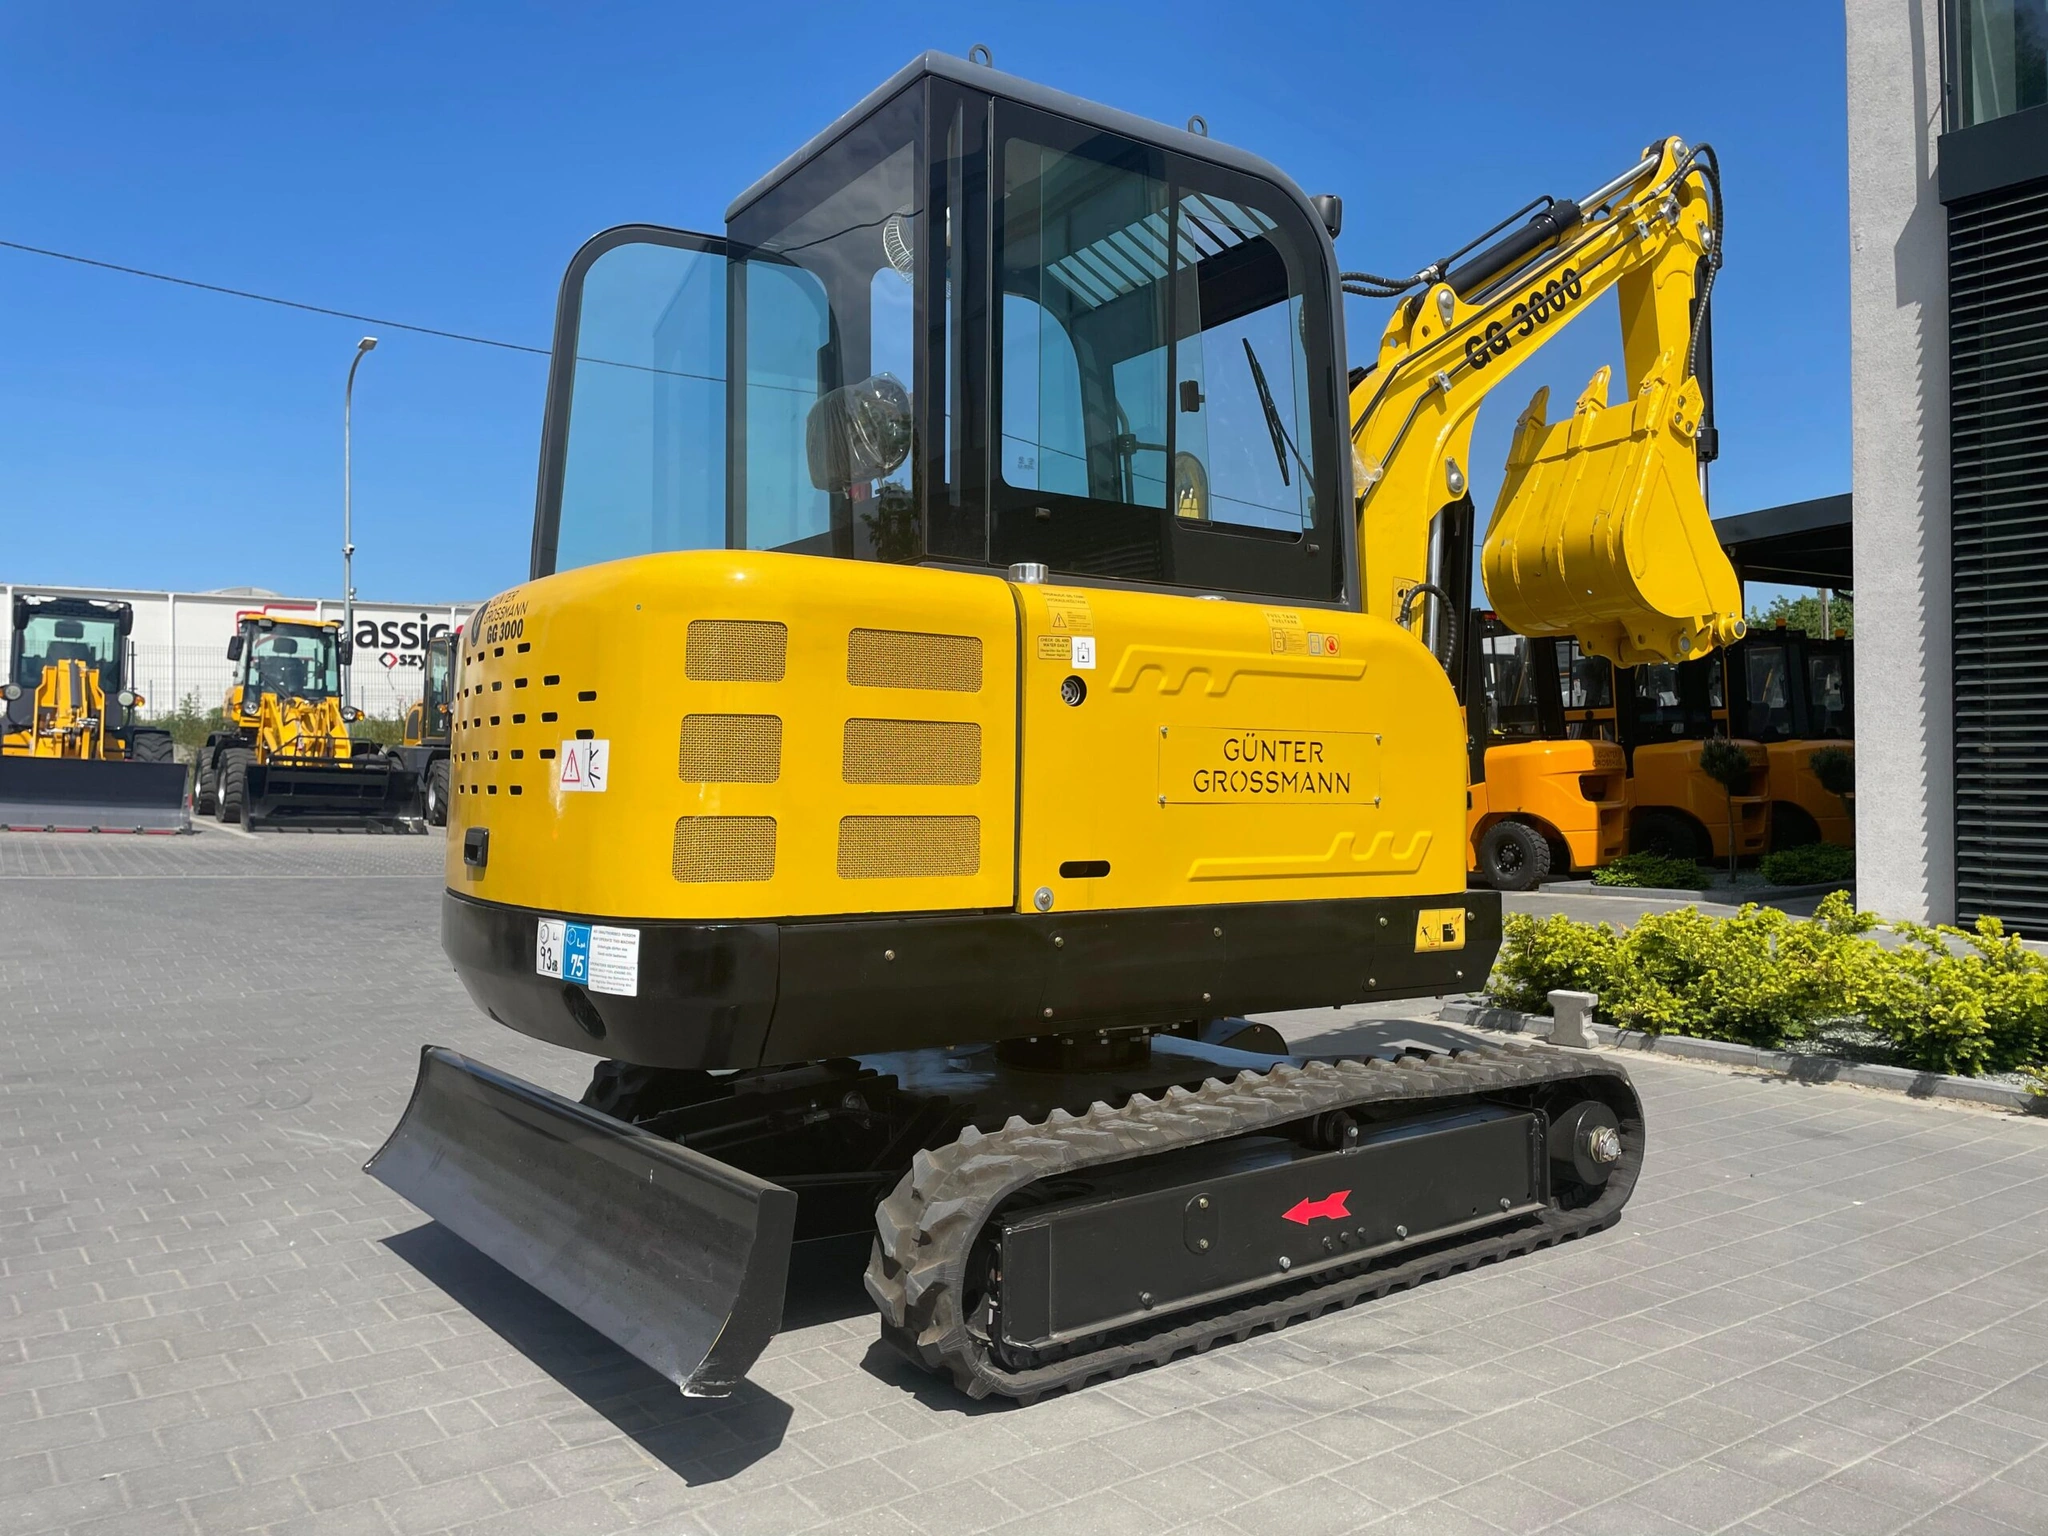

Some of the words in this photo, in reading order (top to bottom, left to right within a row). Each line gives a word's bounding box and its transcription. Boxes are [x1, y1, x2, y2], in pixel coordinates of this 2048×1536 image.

[1465, 321, 1512, 370] GG
[1512, 268, 1582, 336] 3000
[355, 613, 450, 649] assic
[486, 623, 498, 644] GG
[499, 618, 524, 641] 3000
[1223, 733, 1324, 763] GÜNTER
[1193, 769, 1351, 794] GROSSMANN
[570, 953, 585, 977] 75
